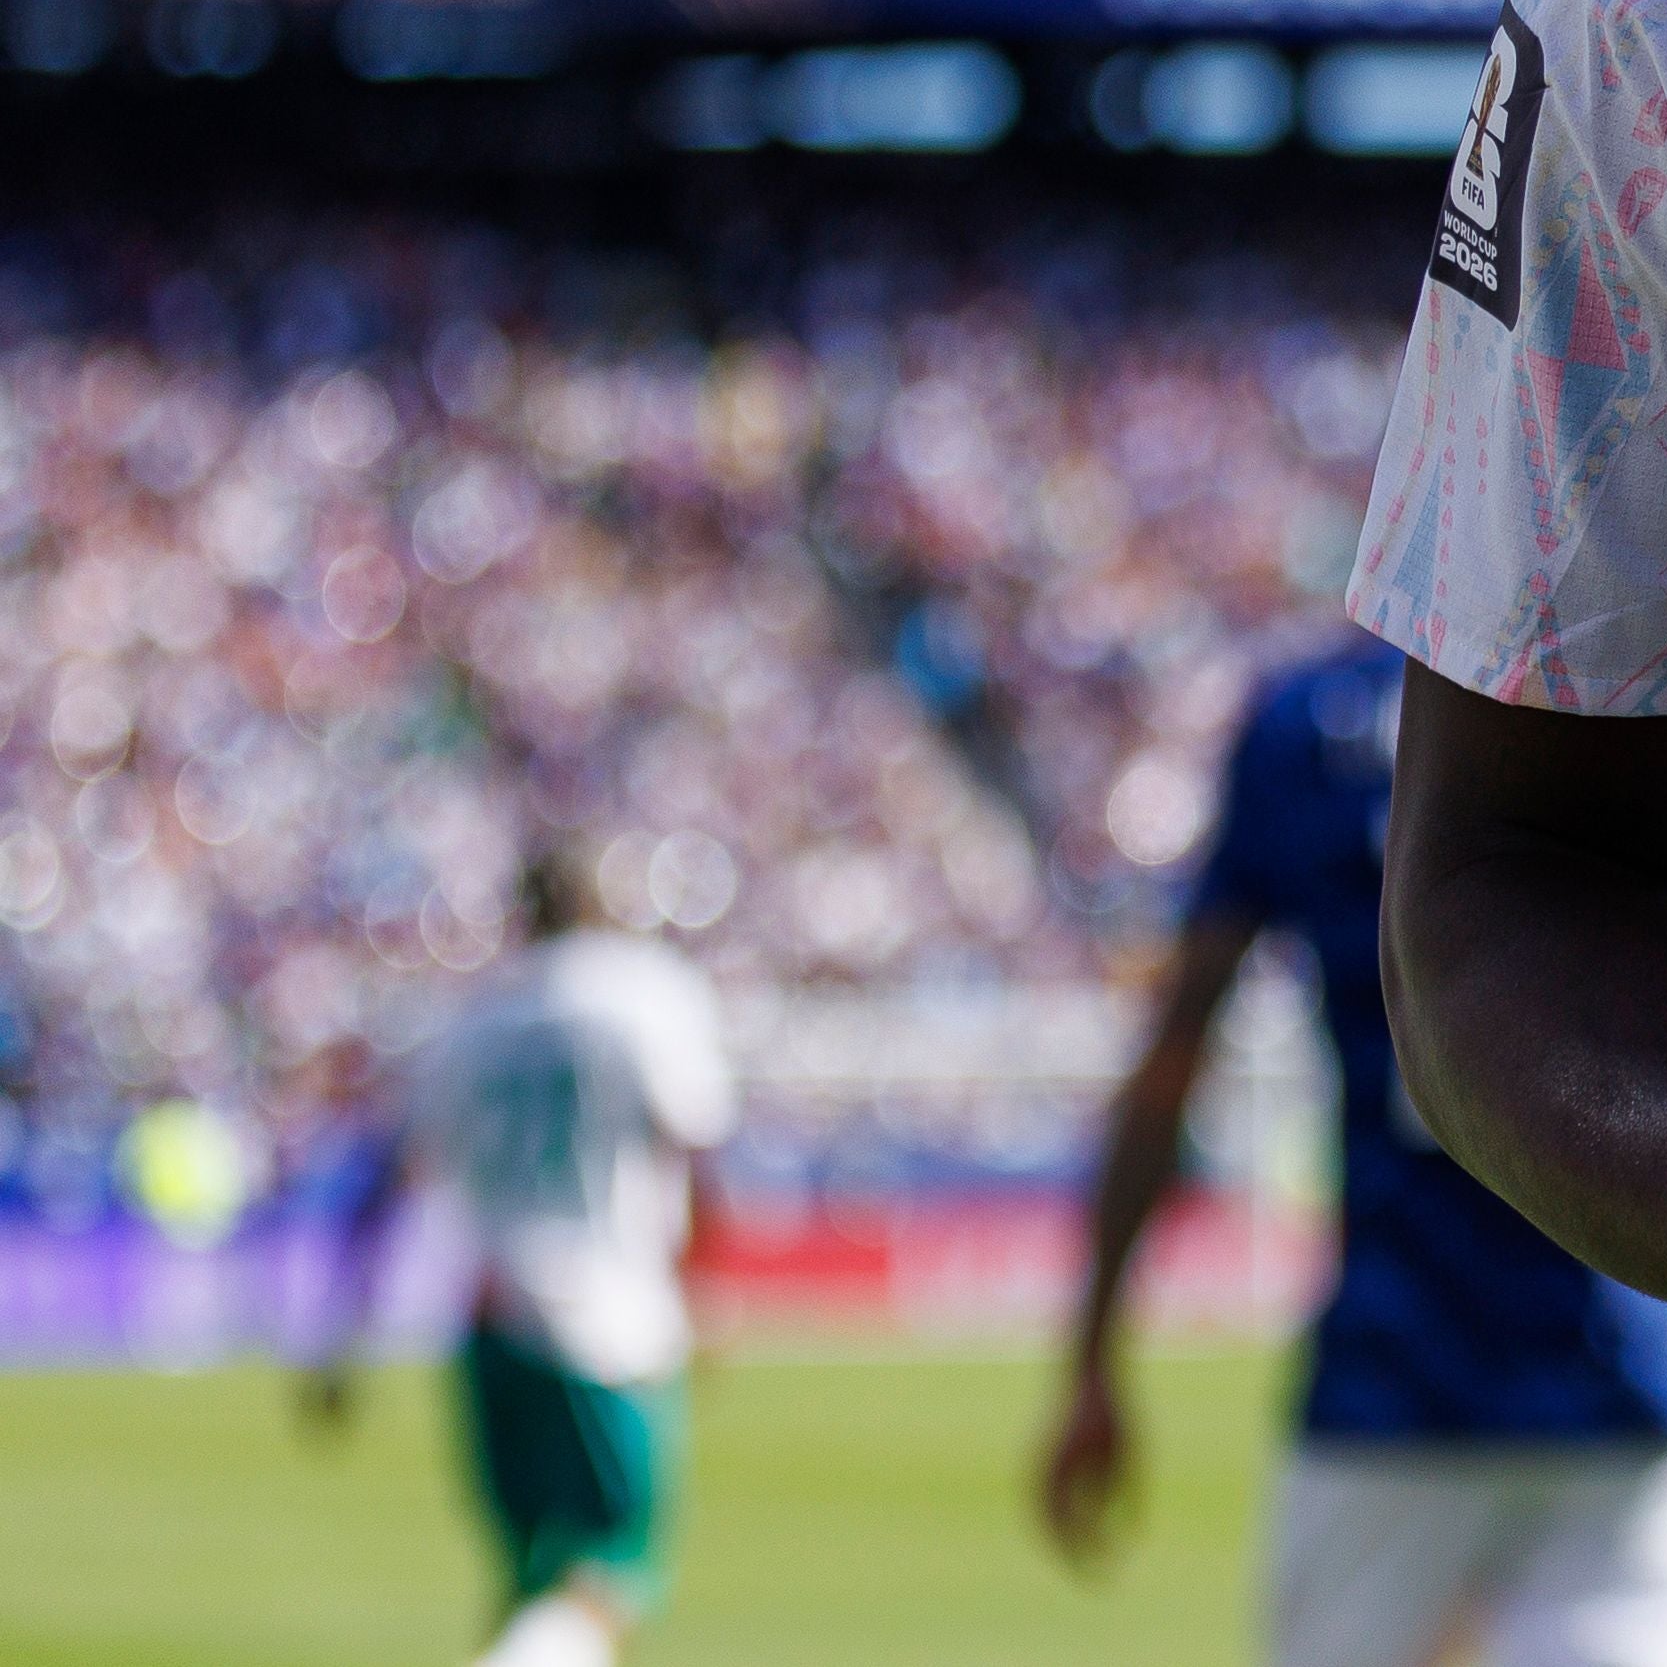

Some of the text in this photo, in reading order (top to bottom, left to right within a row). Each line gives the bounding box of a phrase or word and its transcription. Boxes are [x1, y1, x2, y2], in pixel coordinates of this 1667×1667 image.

[1461, 176, 1485, 211] FIFA
[1444, 210, 1497, 261] WORLD CUP
[1439, 232, 1498, 291] 2026
